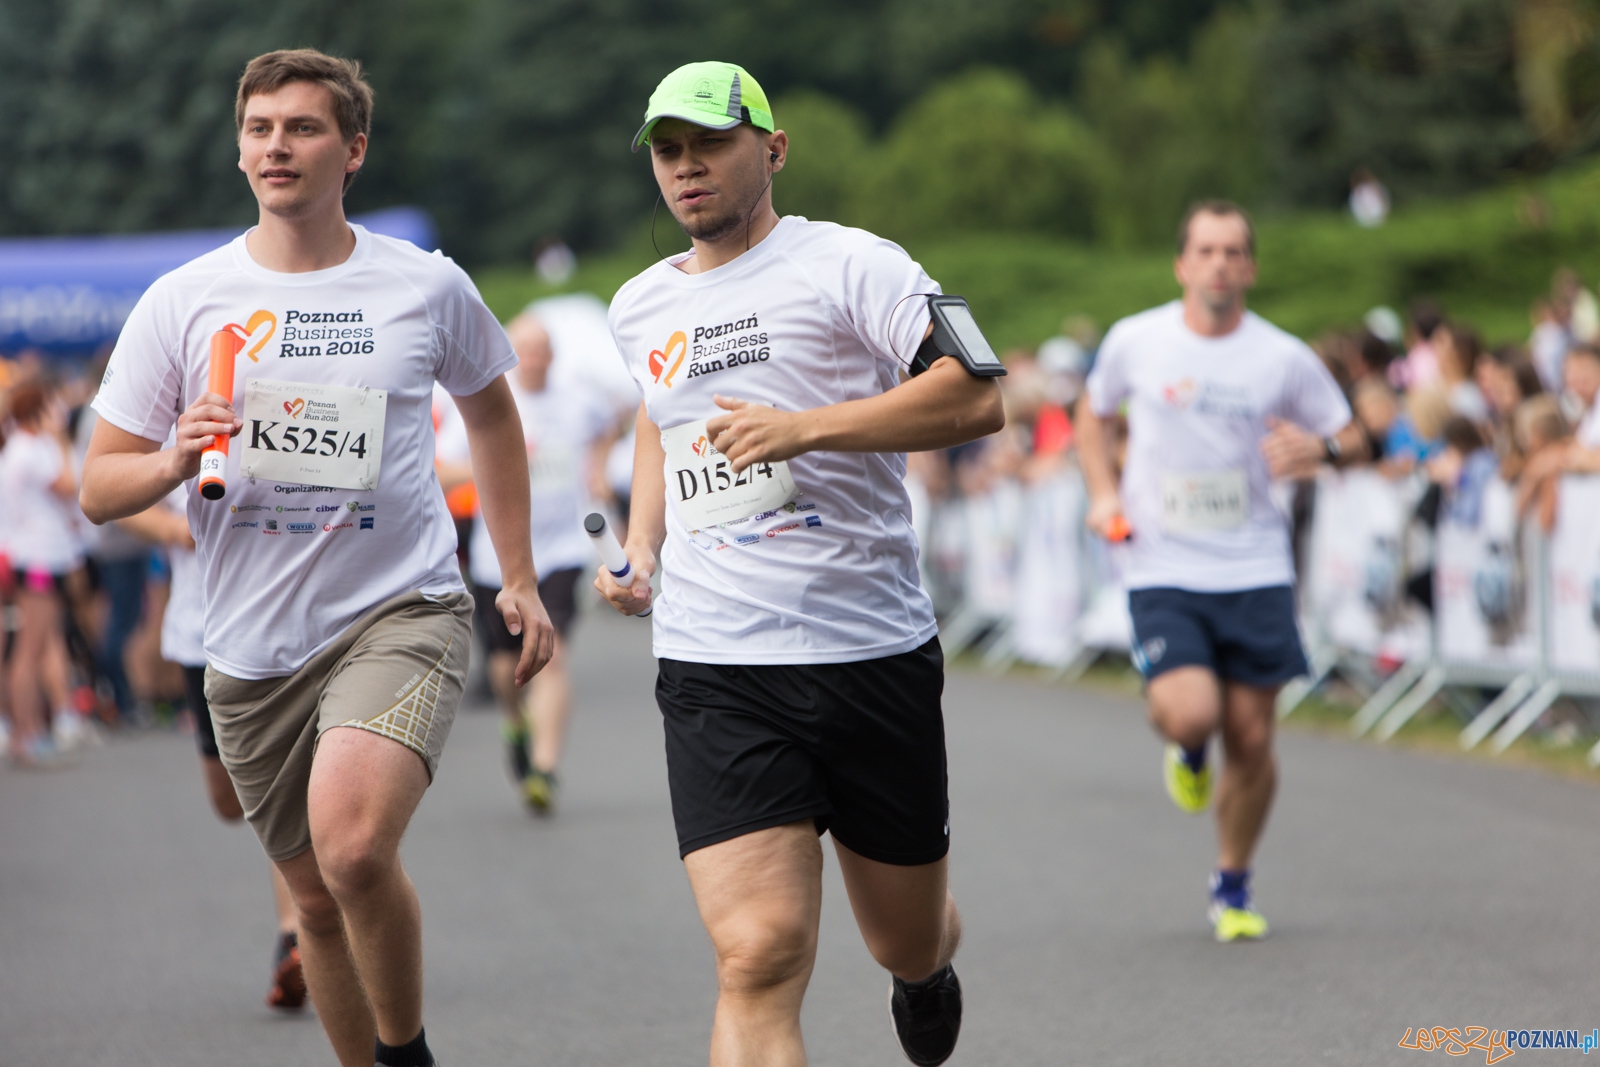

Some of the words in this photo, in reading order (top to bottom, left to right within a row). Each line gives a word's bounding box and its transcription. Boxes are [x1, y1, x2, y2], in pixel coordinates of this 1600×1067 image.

[285, 309, 363, 324] Poznań
[282, 326, 374, 341] Business
[693, 312, 758, 343] Poznań
[279, 344, 321, 358] Run
[326, 341, 375, 355] 2016
[691, 332, 768, 361] Business
[687, 359, 724, 379] Run
[726, 347, 770, 368] 2016
[305, 407, 340, 415] Business
[307, 400, 337, 409] Poznań
[303, 413, 320, 421] Run
[248, 419, 367, 459] K525/4
[775, 523, 800, 533] VEOLIA
